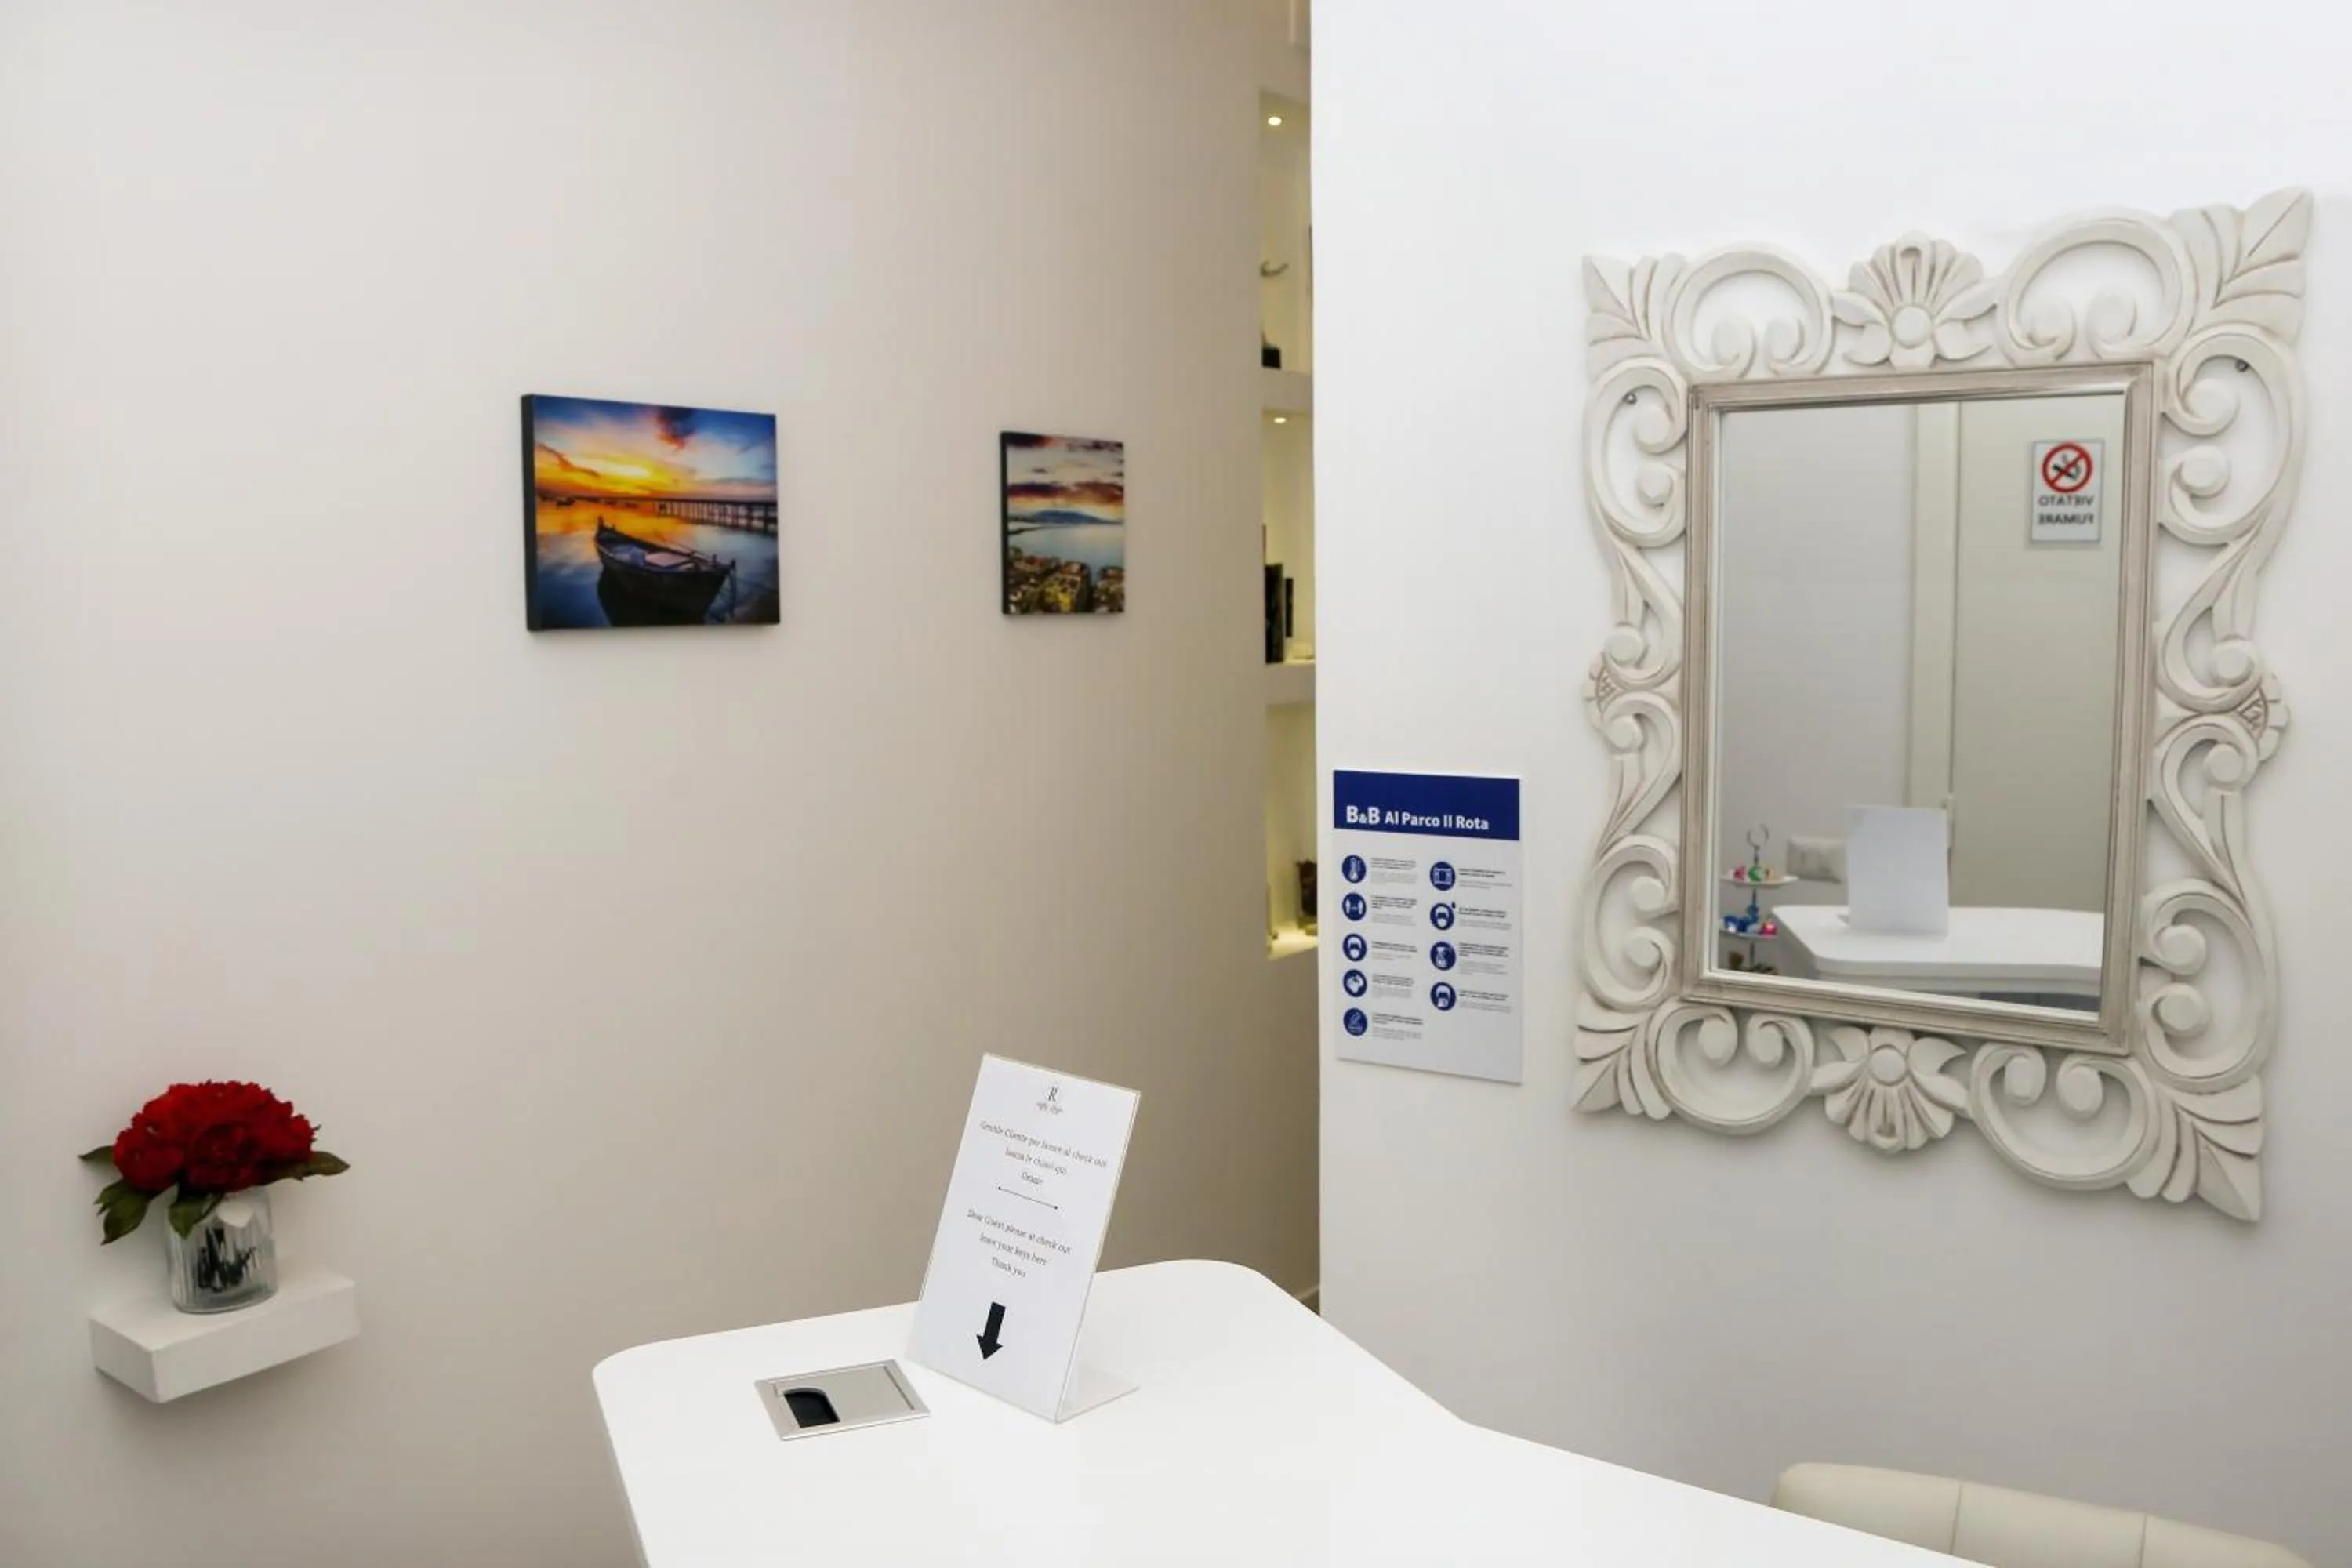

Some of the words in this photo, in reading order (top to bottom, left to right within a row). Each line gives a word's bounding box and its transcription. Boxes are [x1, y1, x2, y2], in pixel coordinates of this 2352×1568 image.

[1346, 805, 1381, 825] B&B
[1385, 811, 1399, 825] Al
[1402, 812, 1440, 828] Parco
[1456, 815, 1490, 830] Rota
[1028, 1138, 1040, 1148] per
[1073, 1150, 1092, 1163] check
[1004, 1224, 1027, 1237] please
[1036, 1235, 1057, 1250] check
[1058, 1243, 1071, 1254] out
[992, 1256, 1012, 1272] Thank
[1012, 1265, 1026, 1277] you
[1014, 1244, 1030, 1260] keys
[1031, 1254, 1047, 1265] here
